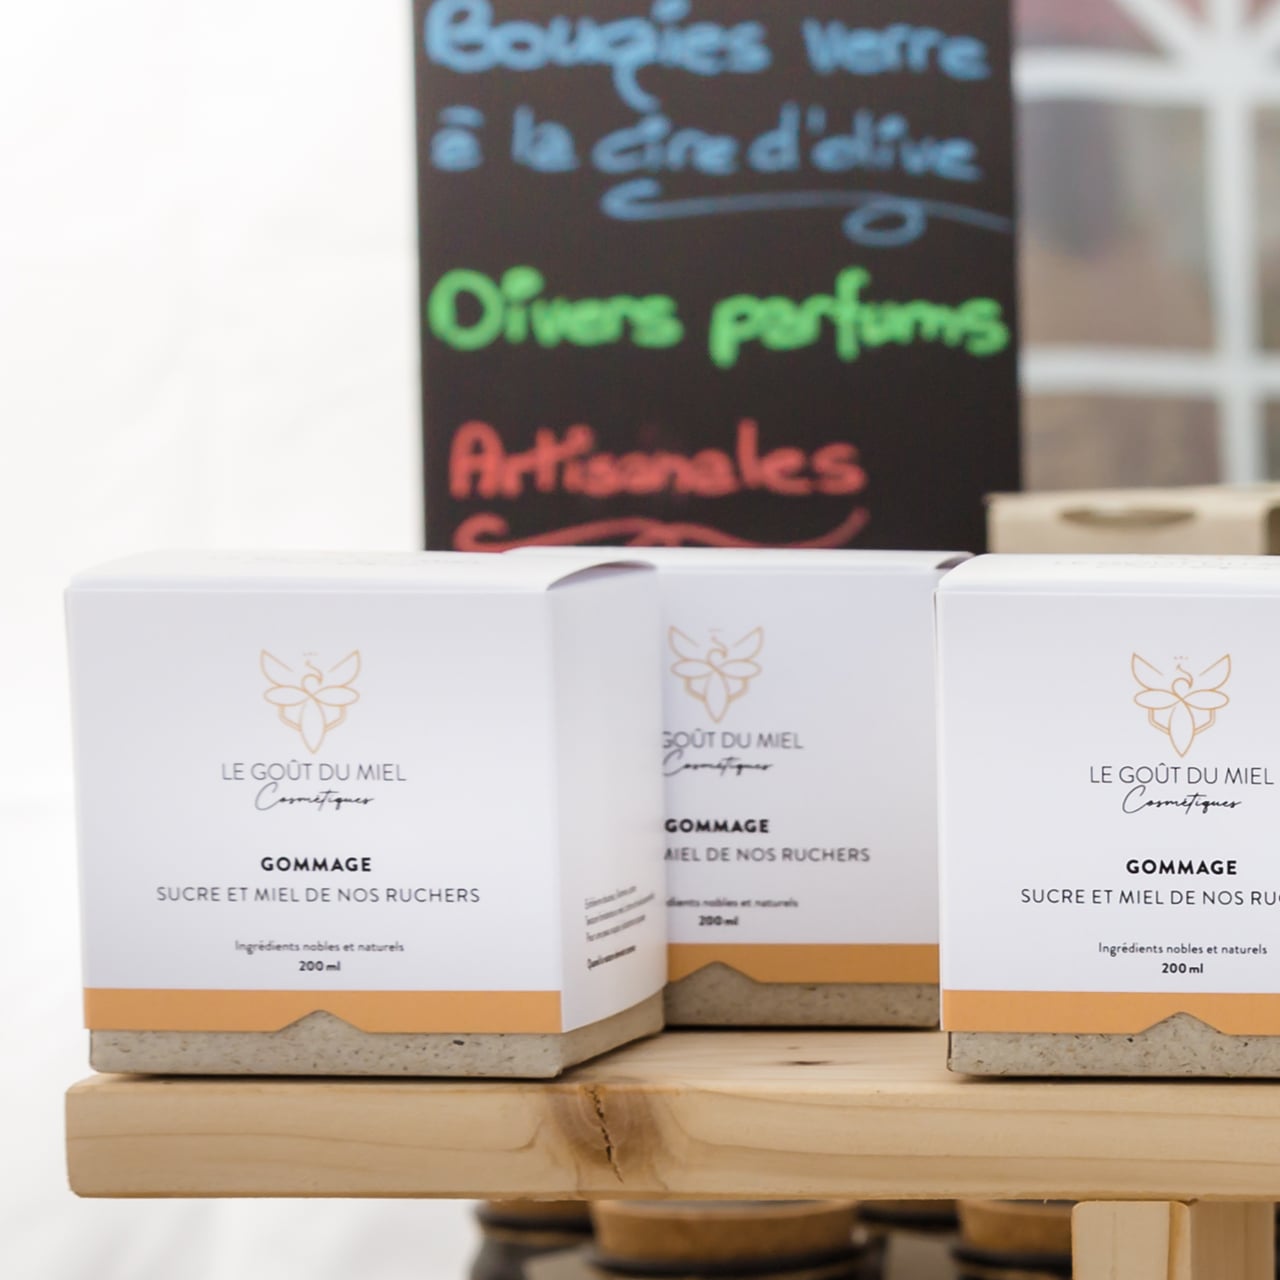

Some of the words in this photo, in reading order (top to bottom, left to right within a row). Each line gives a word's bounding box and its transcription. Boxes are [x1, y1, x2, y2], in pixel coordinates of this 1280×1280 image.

[424, 0, 771, 113] Bougies
[511, 104, 579, 173] la
[593, 113, 740, 175] cire
[428, 266, 684, 351] Divers
[709, 266, 1009, 369] parfums
[449, 418, 868, 499] Artisanales
[1089, 765, 1113, 784] LE
[1118, 762, 1182, 786] GOÛT
[1186, 766, 1218, 785] DU
[1224, 766, 1275, 785] MIEL
[1121, 784, 1241, 815] Cosmétiques
[260, 856, 372, 873] GOMMAGE
[1125, 858, 1237, 875] GOMMAGE
[1020, 887, 1085, 904] SUCRE
[1091, 888, 1113, 904] ET
[1118, 889, 1164, 905] MIEL
[1170, 889, 1196, 905] DE
[1202, 890, 1244, 906] NOS
[1098, 941, 1164, 958] Ingrédients
[1165, 942, 1204, 954] nobles
[1205, 945, 1218, 955] et
[1220, 943, 1268, 955] naturels
[1161, 961, 1187, 974] 200
[1188, 962, 1204, 974] ml
